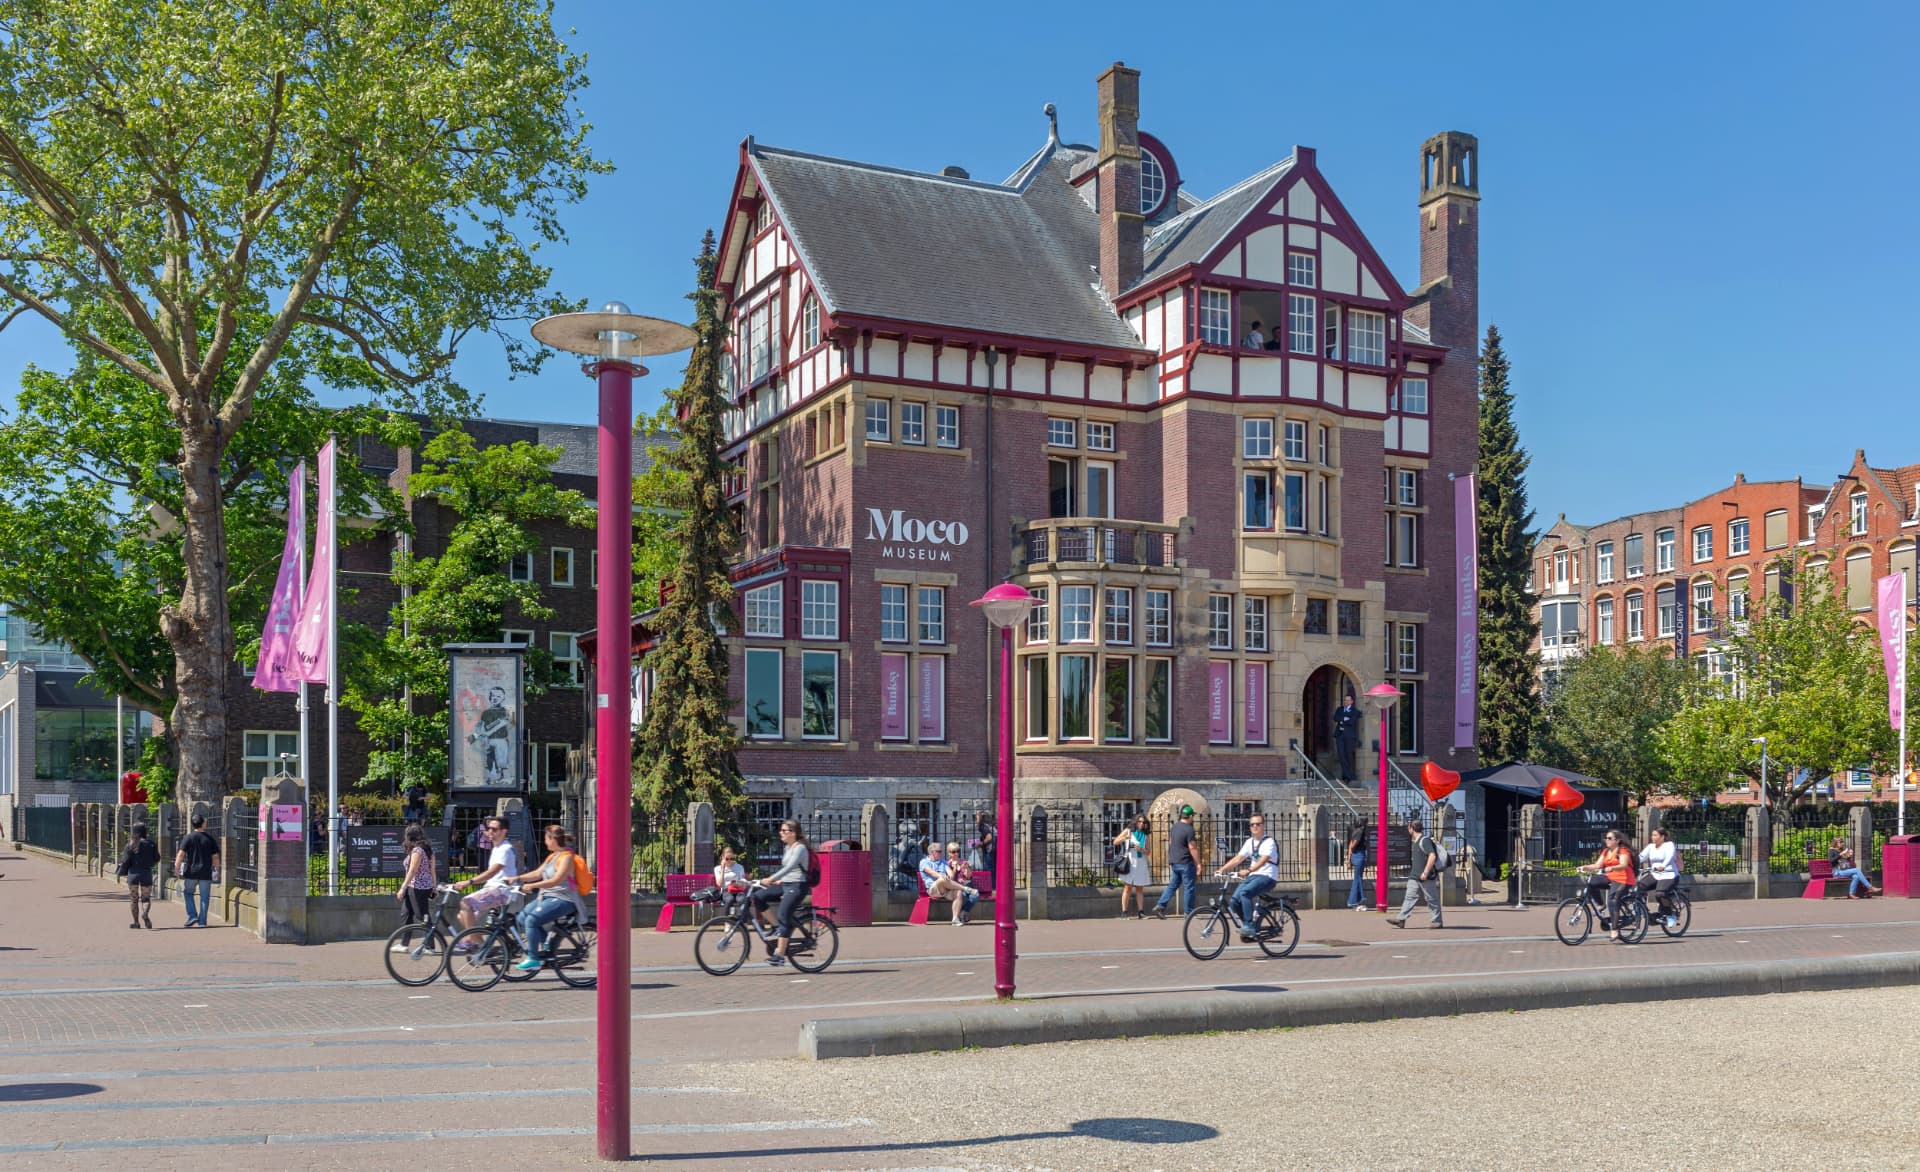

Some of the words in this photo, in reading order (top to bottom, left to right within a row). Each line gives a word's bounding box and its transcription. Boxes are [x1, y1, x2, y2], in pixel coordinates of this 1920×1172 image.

[864, 507, 969, 546] Moco
[882, 546, 951, 562] MUSEUM
[1461, 554, 1474, 617] Banksy
[1676, 602, 1684, 647] ACADEMY
[1461, 632, 1475, 694] Banksy
[887, 671, 900, 716] Banksy
[1212, 677, 1223, 720] Banksy
[1583, 809, 1617, 823] Moco
[351, 837, 378, 847] Moco
